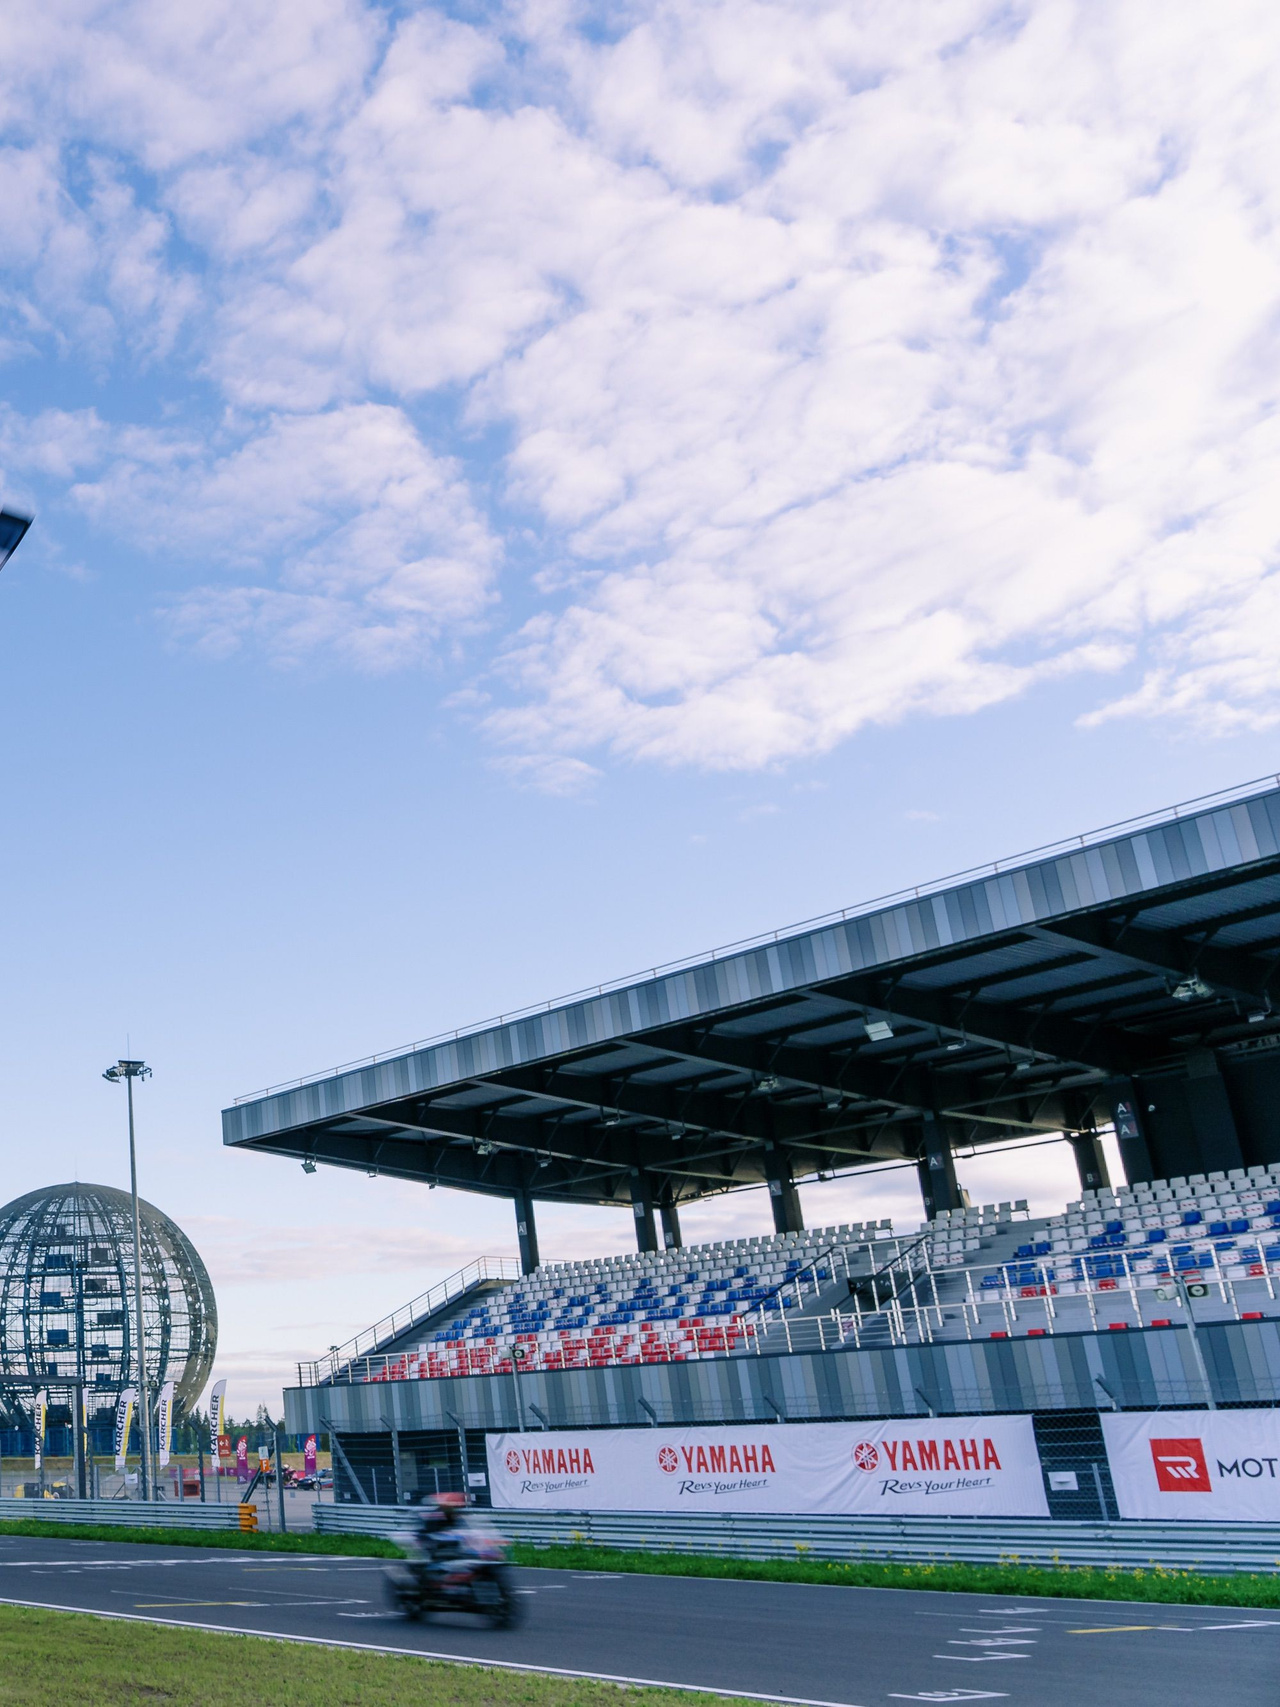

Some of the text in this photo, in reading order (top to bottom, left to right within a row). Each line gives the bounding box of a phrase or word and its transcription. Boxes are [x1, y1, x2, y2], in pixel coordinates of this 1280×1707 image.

[521, 1448, 595, 1474] YAMAHA
[680, 1444, 776, 1473] YAMAHA
[882, 1438, 1002, 1471] YAMAHA
